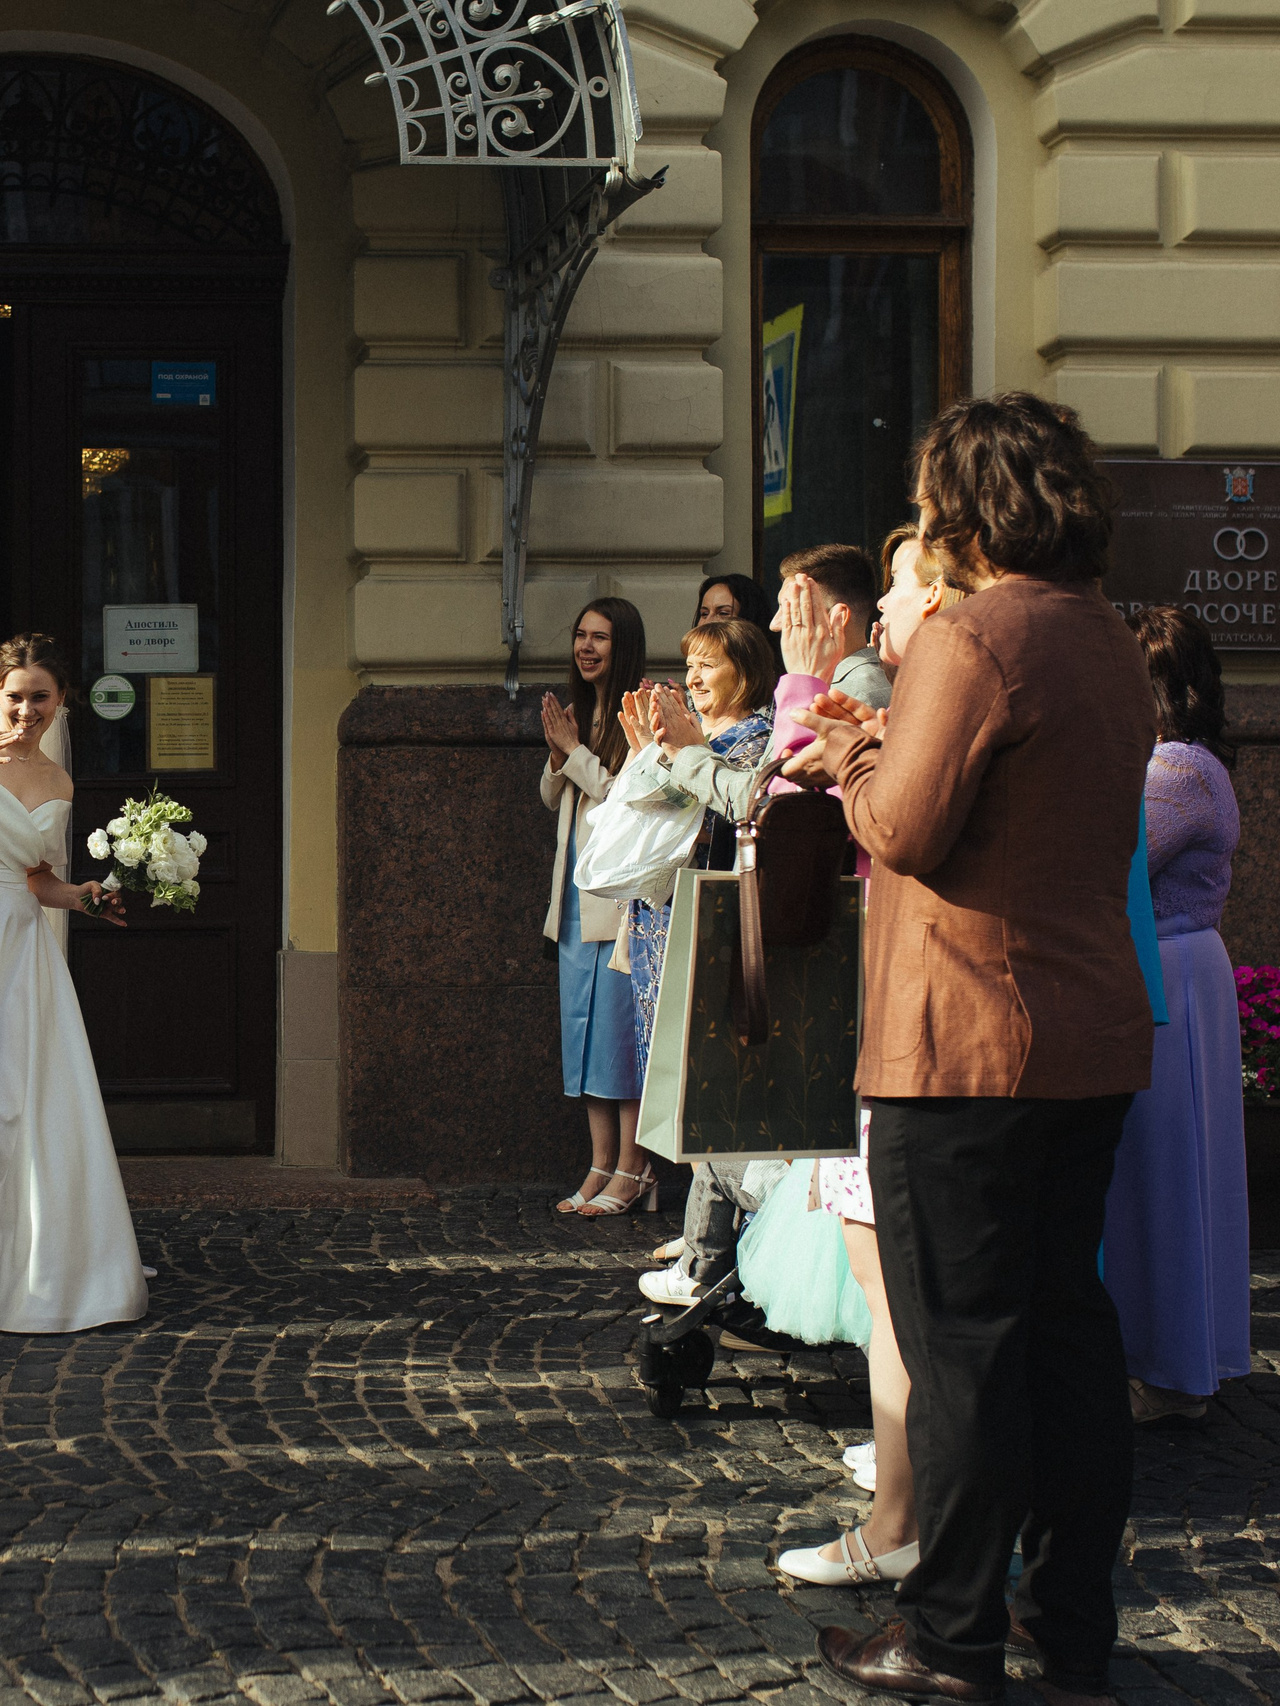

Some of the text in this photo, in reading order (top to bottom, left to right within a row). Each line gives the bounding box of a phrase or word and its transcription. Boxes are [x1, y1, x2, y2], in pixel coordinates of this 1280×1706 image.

[1183, 570, 1278, 593] ДВОРЕ
[125, 619, 178, 630] Апостиль
[129, 637, 175, 647] во дворе
